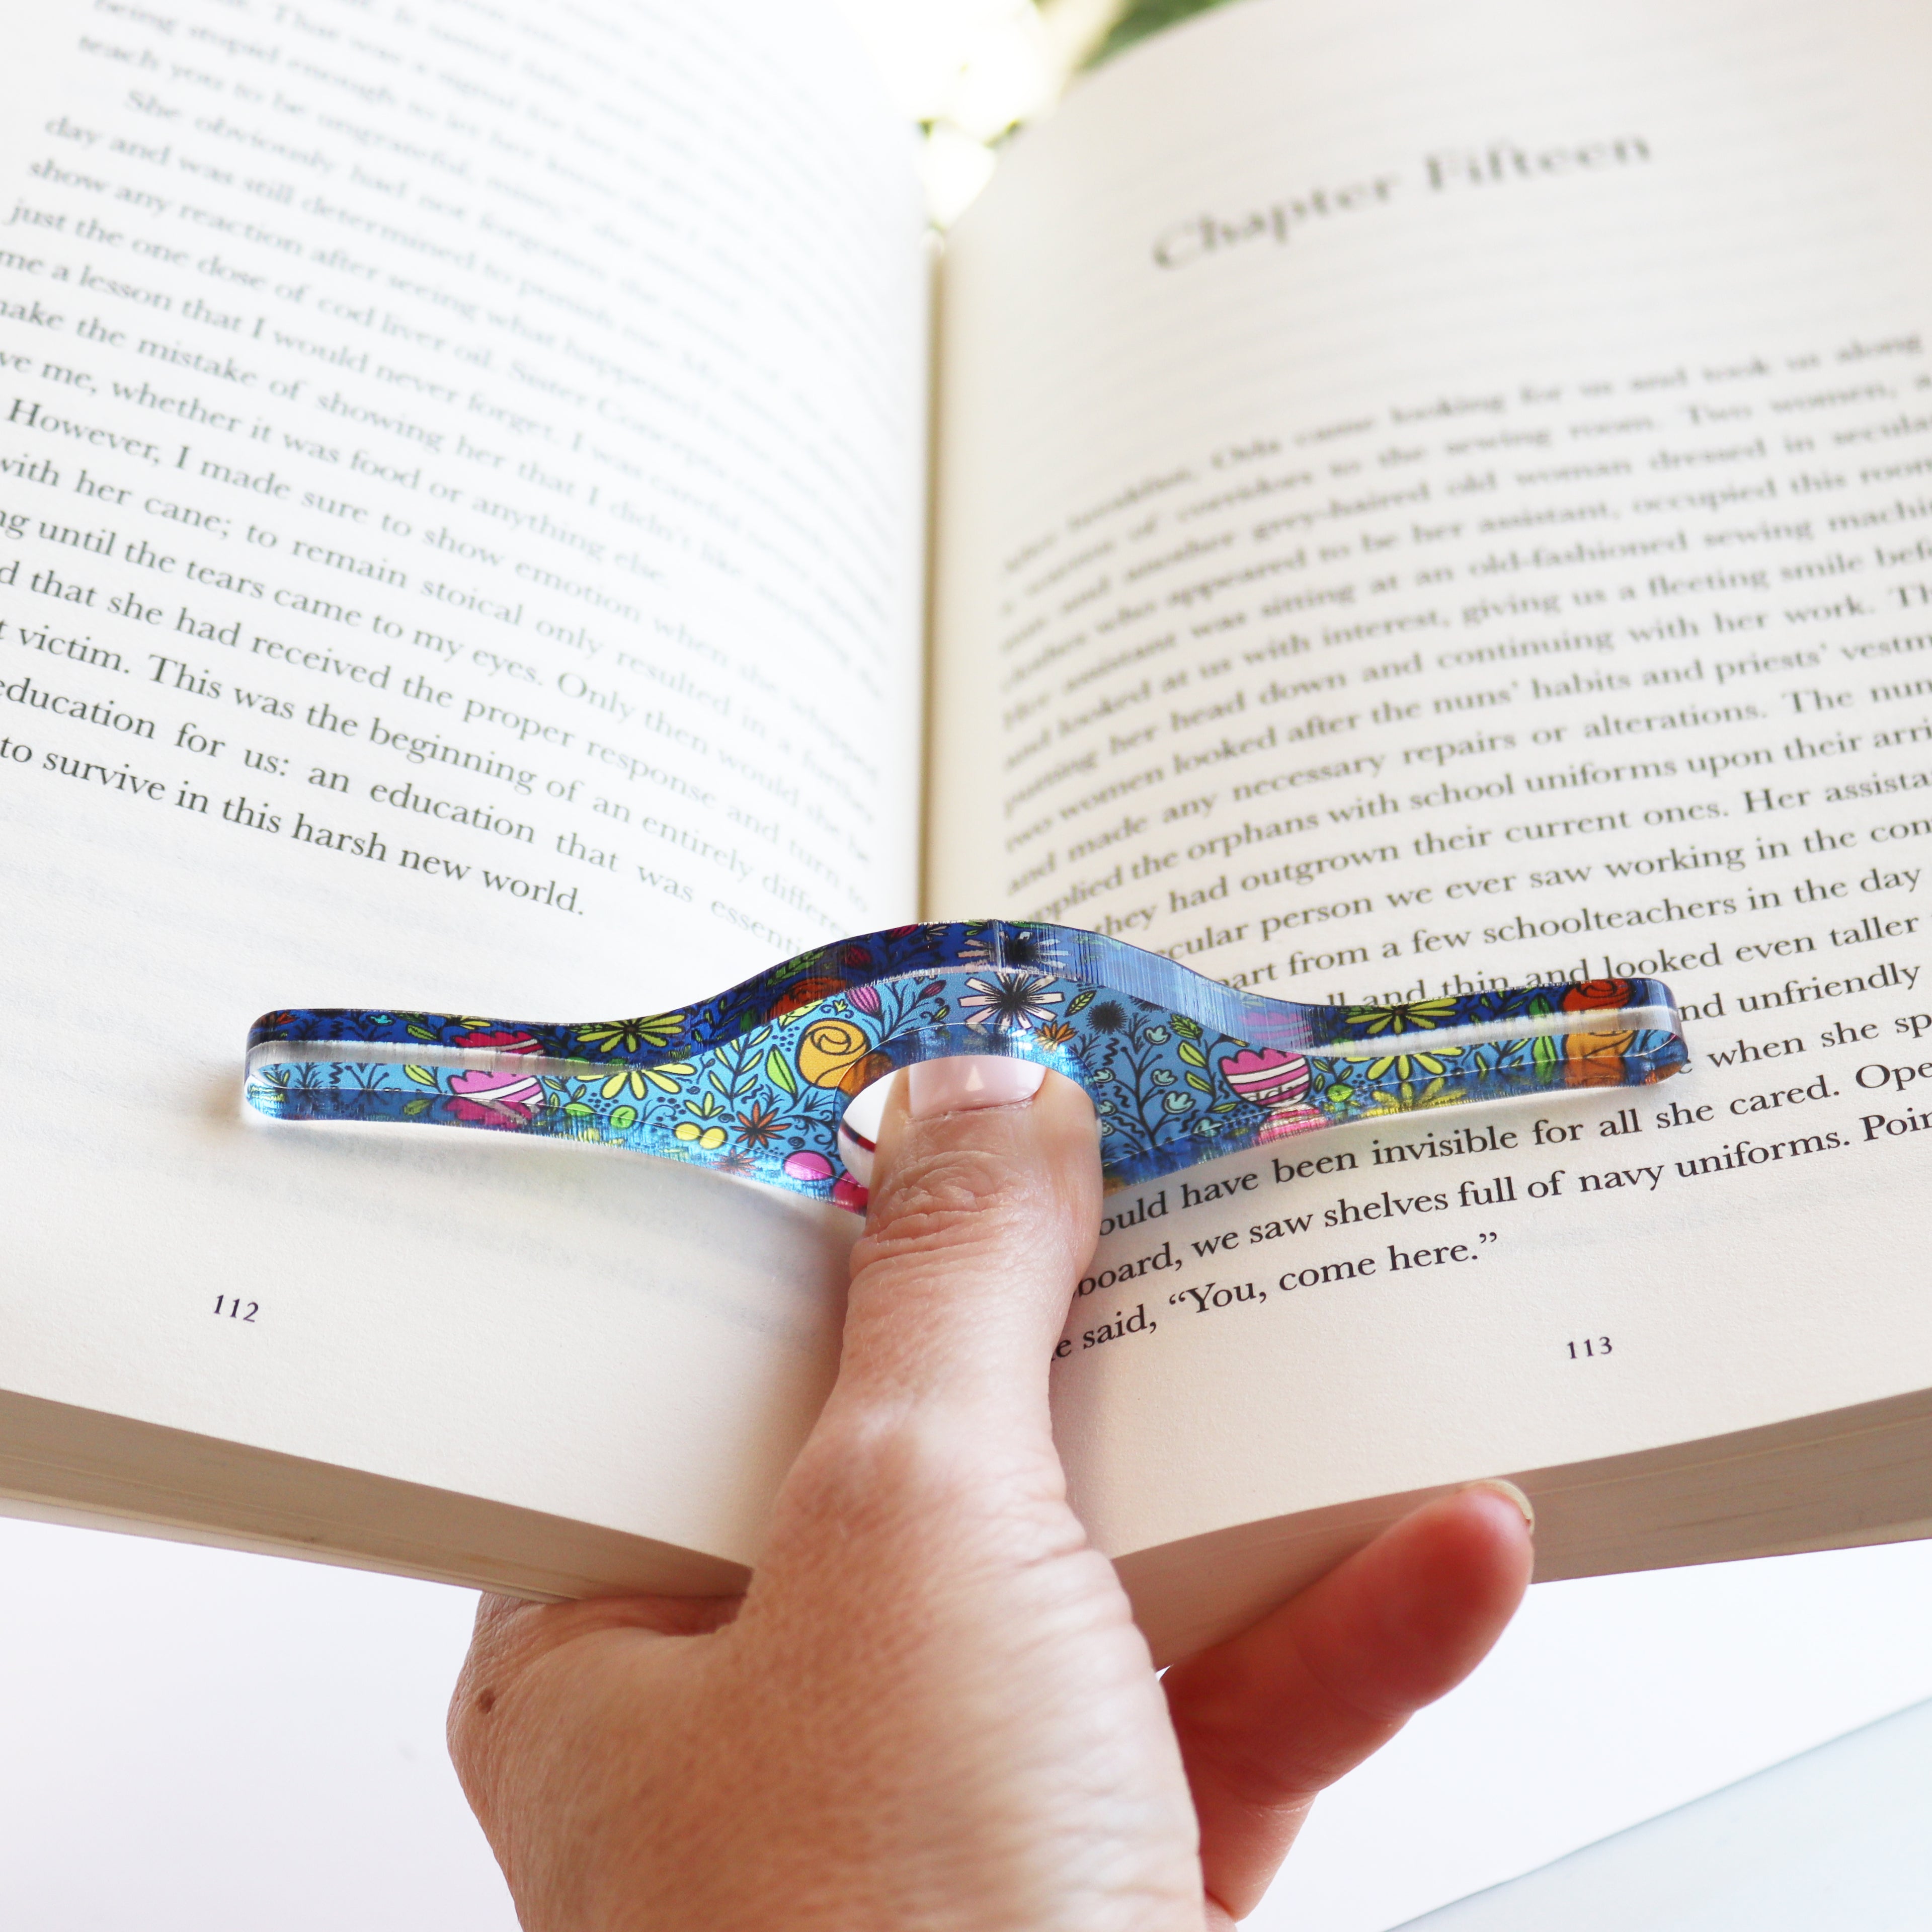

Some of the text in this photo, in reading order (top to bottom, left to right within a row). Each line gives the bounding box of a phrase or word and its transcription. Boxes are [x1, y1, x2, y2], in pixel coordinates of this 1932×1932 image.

[29, 158, 172, 216] show any
[1152, 137, 1651, 270] Chapter Fifteen
[3, 198, 311, 304] just the one dose of
[51, 264, 370, 374] a lesson that I would
[41, 363, 464, 503] me, whether it was food or
[76, 316, 445, 454] the mistake of showing
[6, 398, 640, 623] However, I made sure to show emotion
[74, 469, 603, 659] her cane; to remain stoical only
[1414, 519, 1815, 587] an old-fashioned sewing
[39, 522, 635, 722] until the tears came to my eyes. Only
[1461, 552, 1863, 627] giving us a fleeting smile
[31, 570, 715, 804] that she had received the proper response
[1258, 594, 1875, 705] down and continuing with her work.
[1287, 642, 1827, 743] after the nuns’ habits and priests’
[19, 625, 630, 823] victim. This was the beginning of an
[1232, 689, 1852, 802] necessary repairs or alterations. The
[0, 737, 583, 915] to survive in this harsh new world.
[175, 723, 693, 902] for us: an education that was
[1168, 788, 1810, 913] had outgrown their current ones. Her
[1186, 732, 1862, 860] orphans with school uniforms upon their
[1260, 829, 1855, 942] person we ever saw working in the
[1289, 868, 1920, 976] from a few schoolteachers in the day
[1735, 916, 1919, 961] even taller
[1737, 962, 1920, 1012] unfriendly
[1707, 1022, 1879, 1068] when she
[1180, 1074, 1839, 1209] have been invisible for all she cared.
[1191, 1132, 1850, 1257] we saw shelves full of navy uniforms.
[214, 1295, 259, 1323] 112
[1083, 1232, 1497, 1349] said, “You, come here.”
[1567, 1336, 1613, 1359] 113
